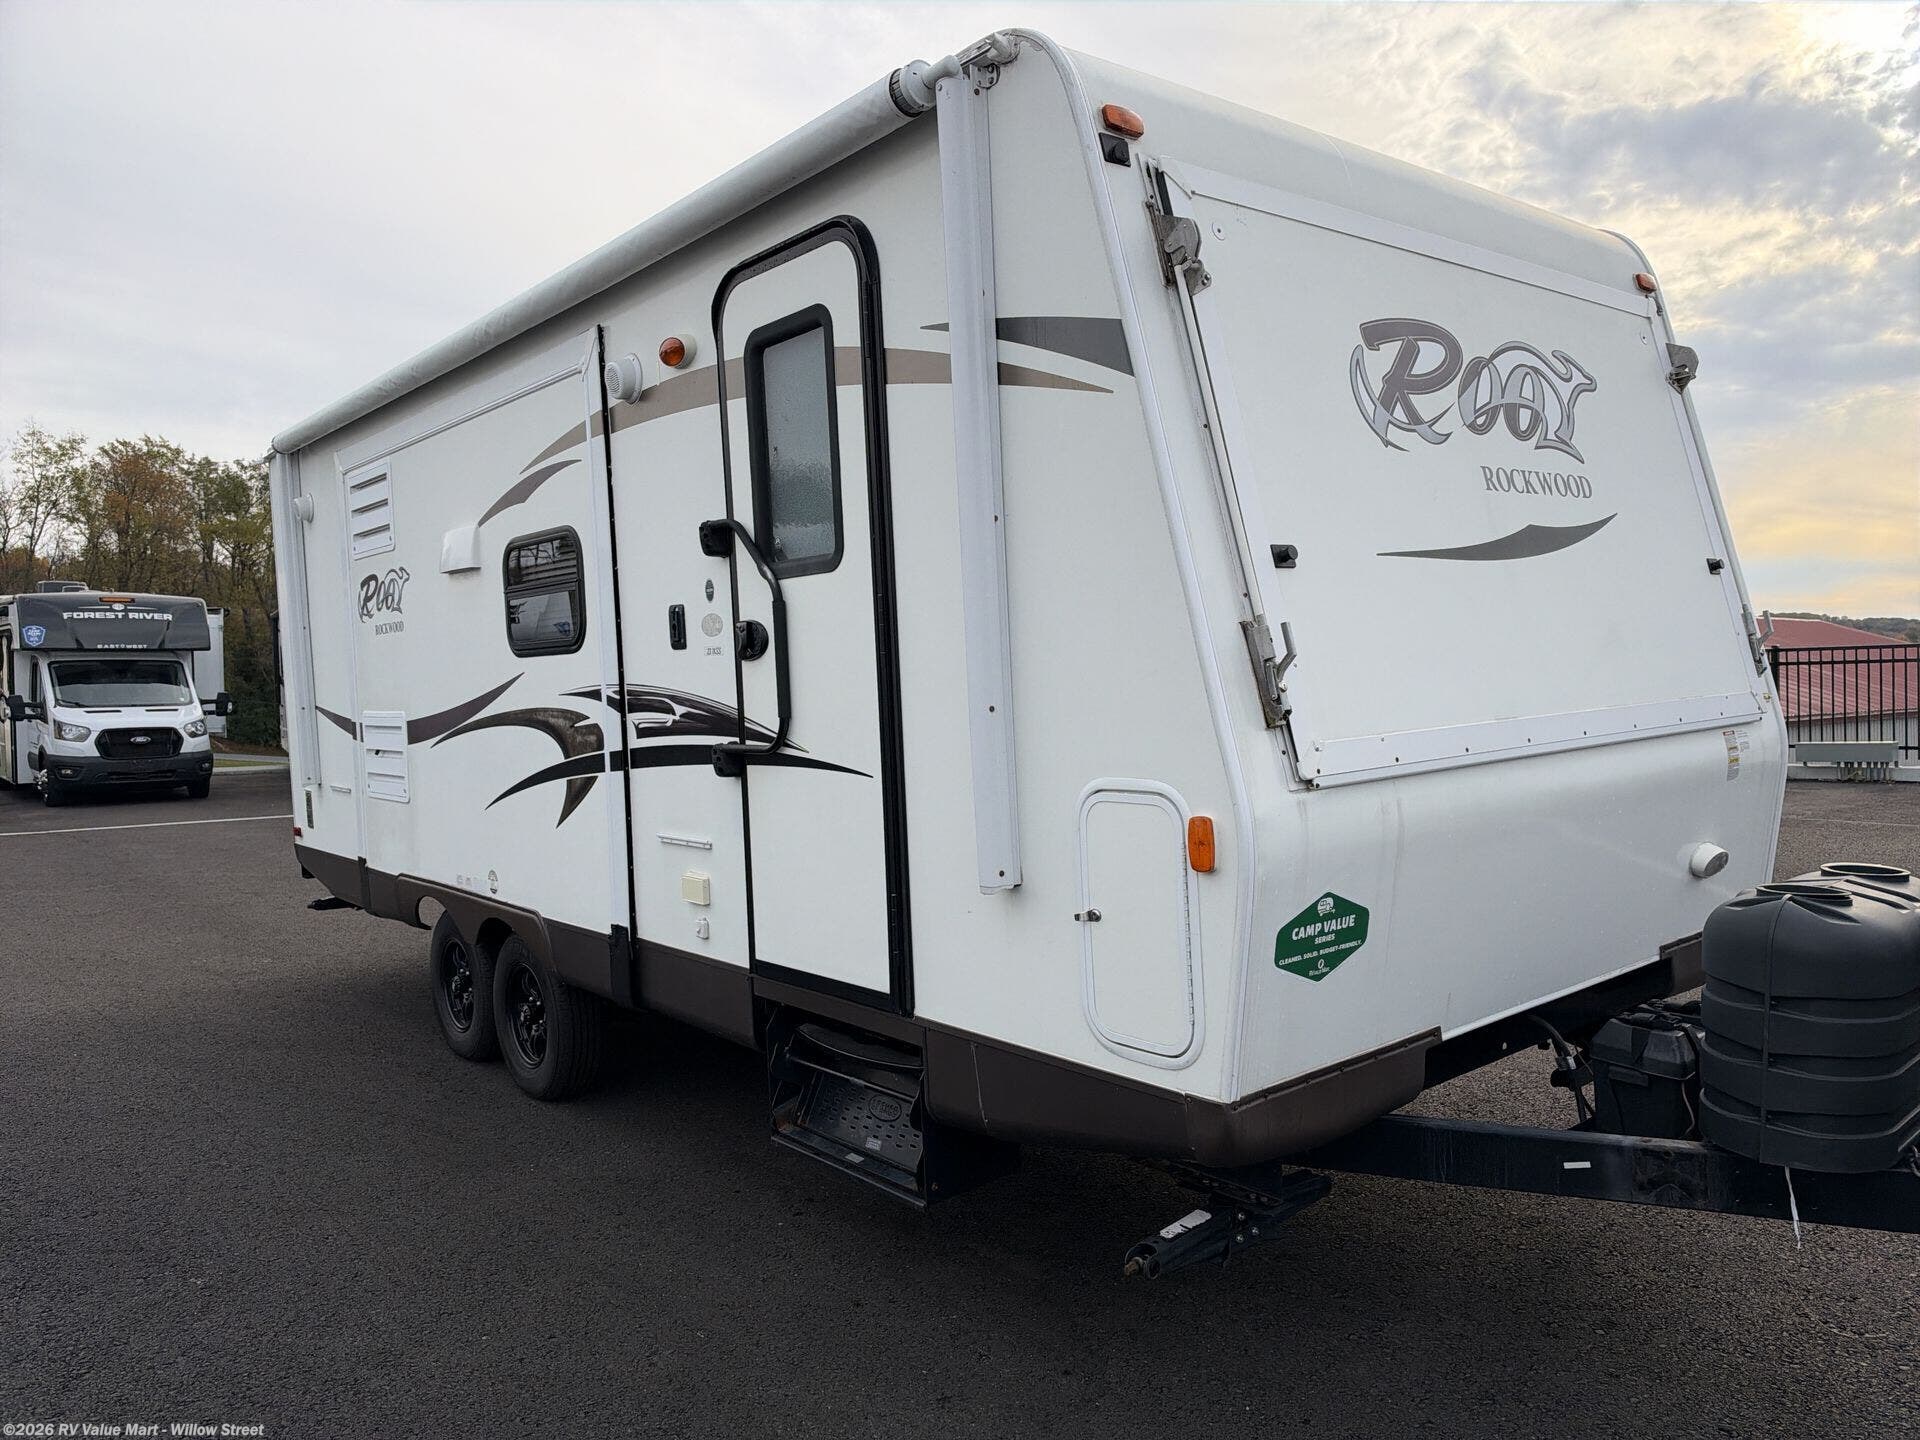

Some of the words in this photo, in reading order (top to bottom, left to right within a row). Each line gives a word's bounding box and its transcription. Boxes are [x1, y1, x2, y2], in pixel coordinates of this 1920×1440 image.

[1480, 465, 1593, 499] ROCKWOOD
[62, 611, 125, 620] FOREST
[128, 611, 173, 621] RIVER
[375, 621, 404, 635] ROCKWOOD
[1292, 922, 1322, 941] CAMP
[1324, 914, 1356, 933] VALUE
[1314, 933, 1336, 945] SERIES
